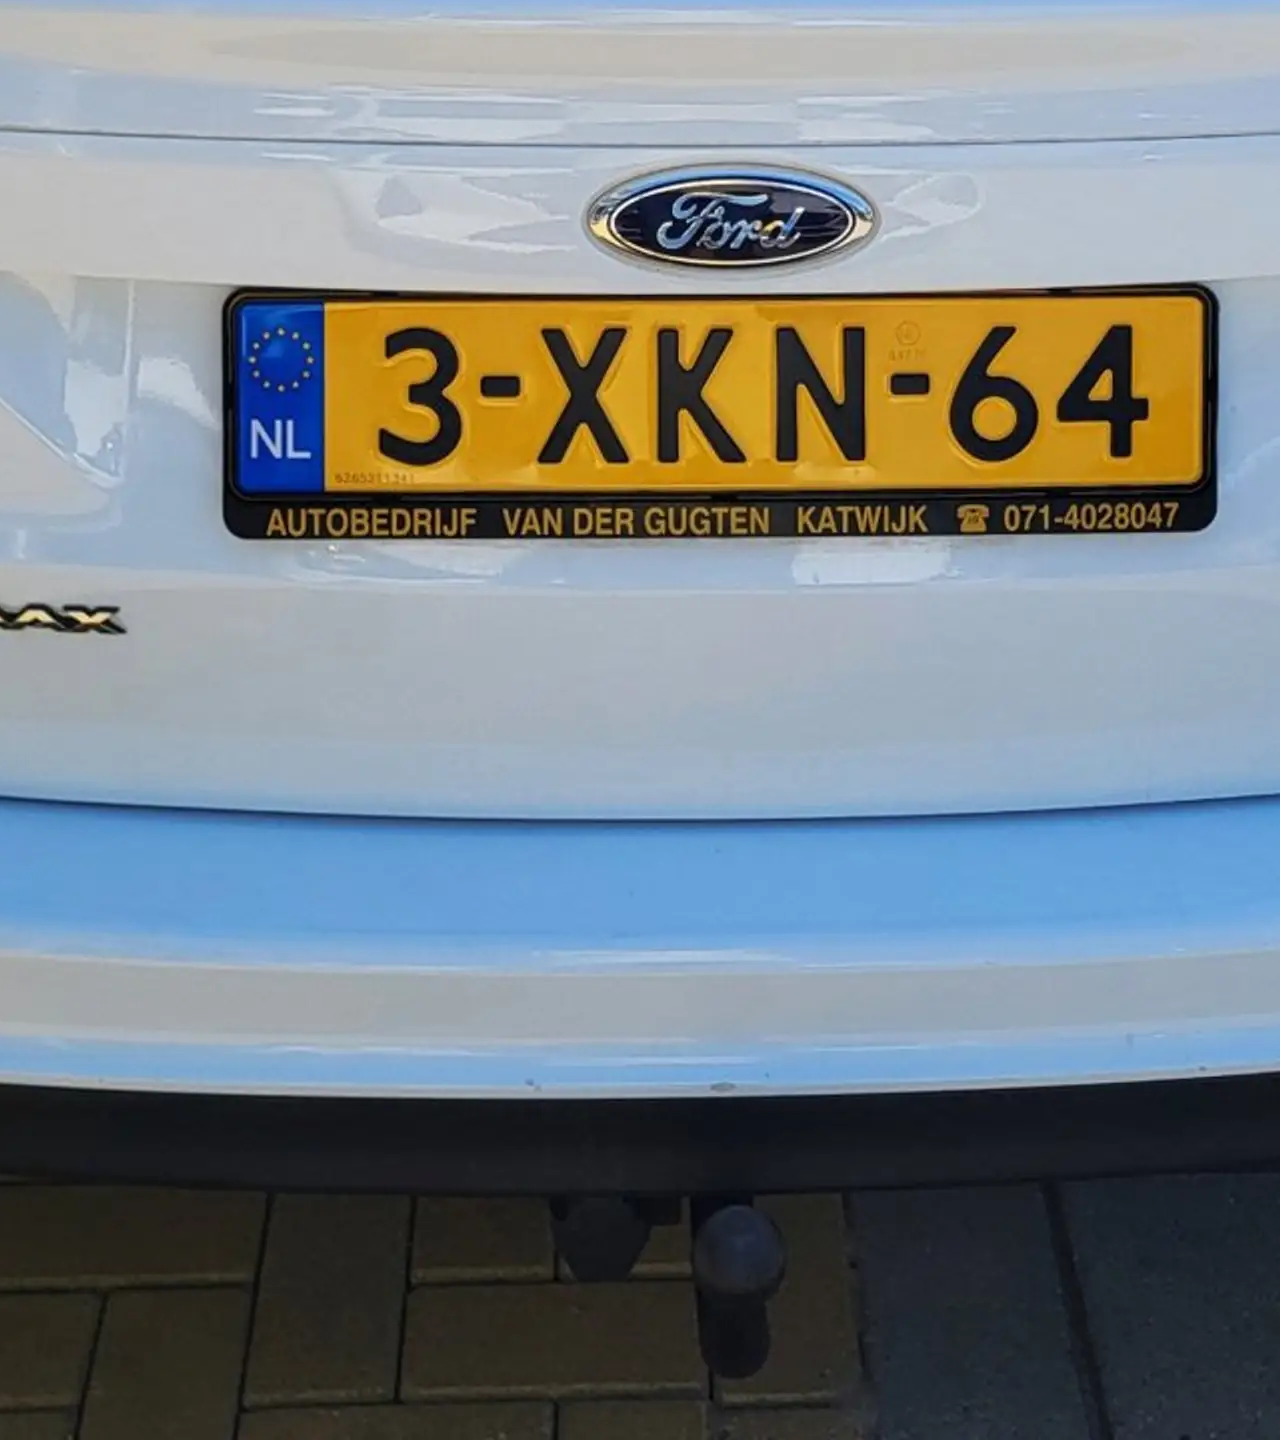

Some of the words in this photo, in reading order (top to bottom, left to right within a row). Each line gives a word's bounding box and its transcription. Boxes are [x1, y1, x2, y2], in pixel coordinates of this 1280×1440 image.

[656, 191, 806, 250] Ford
[378, 325, 1150, 467] 3-XKN-64
[249, 418, 312, 459] NL
[266, 508, 477, 537] AUTOBEDRIJF
[502, 508, 564, 536] VAN
[573, 507, 634, 536] DER
[644, 505, 770, 535] GUGTEN
[797, 505, 929, 534] KATWIJK
[1003, 502, 1179, 532] 071-4028047
